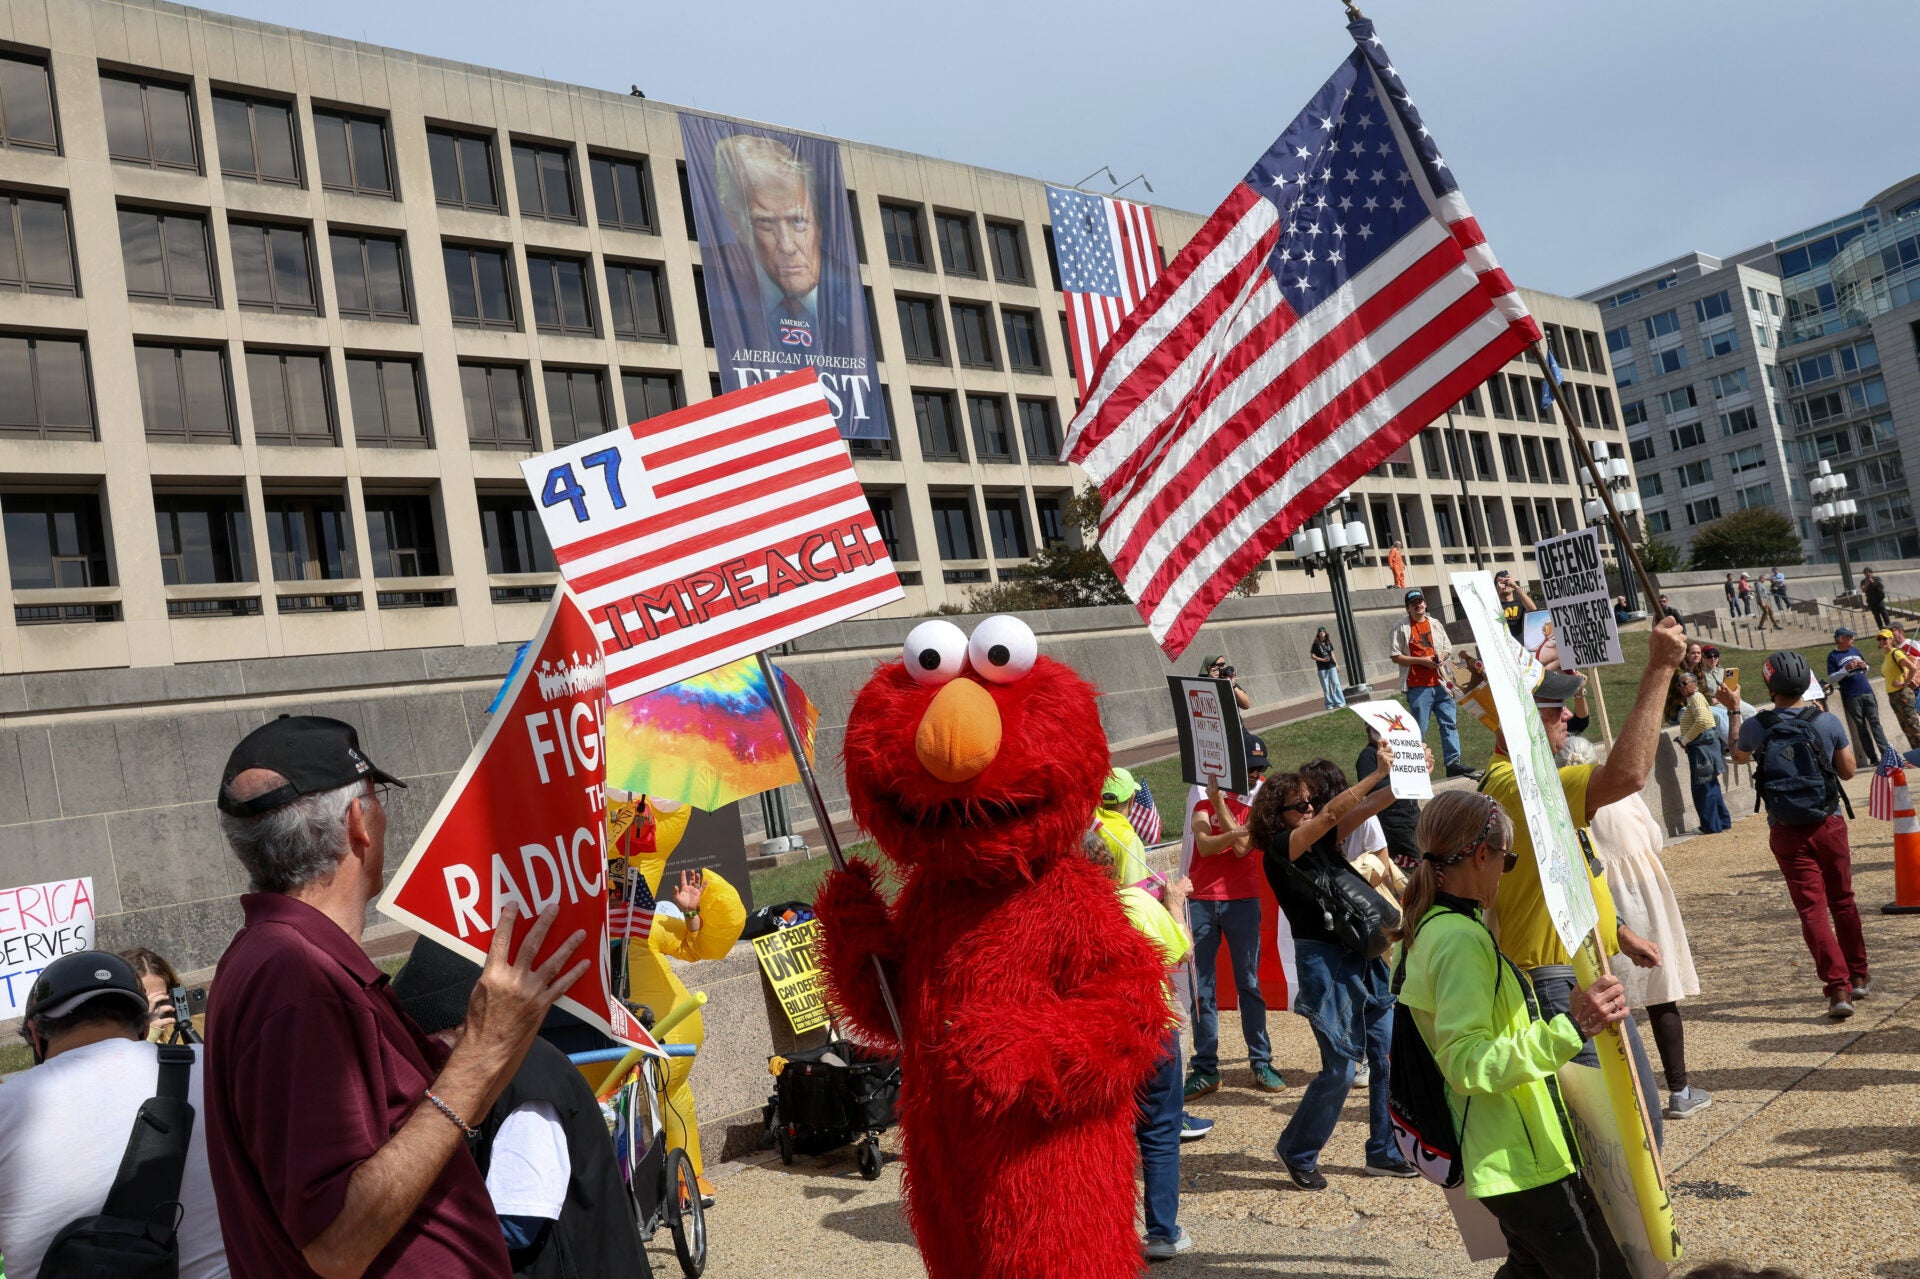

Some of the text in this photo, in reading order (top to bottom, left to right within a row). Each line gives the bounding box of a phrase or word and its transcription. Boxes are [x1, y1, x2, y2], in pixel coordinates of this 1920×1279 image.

[780, 318, 810, 328] AMERICA
[781, 327, 813, 347] 250
[732, 349, 867, 369] AMERICAN WORKERS
[733, 367, 871, 420] FST
[541, 446, 627, 523] 47
[1538, 533, 1599, 580] DEFEND
[604, 523, 876, 650] IMPEACH
[1543, 570, 1604, 600] DEMOCRACY:
[1550, 598, 1611, 628] IT'S TIME FOR
[1563, 620, 1610, 646] A GENERAL
[1572, 641, 1610, 665] STRIKE!
[525, 698, 606, 784] FIGH
[1402, 752, 1425, 760] TRUMP
[755, 924, 816, 957] THE PEOPL
[763, 943, 814, 981] UNIT
[778, 982, 799, 1001] CAN
